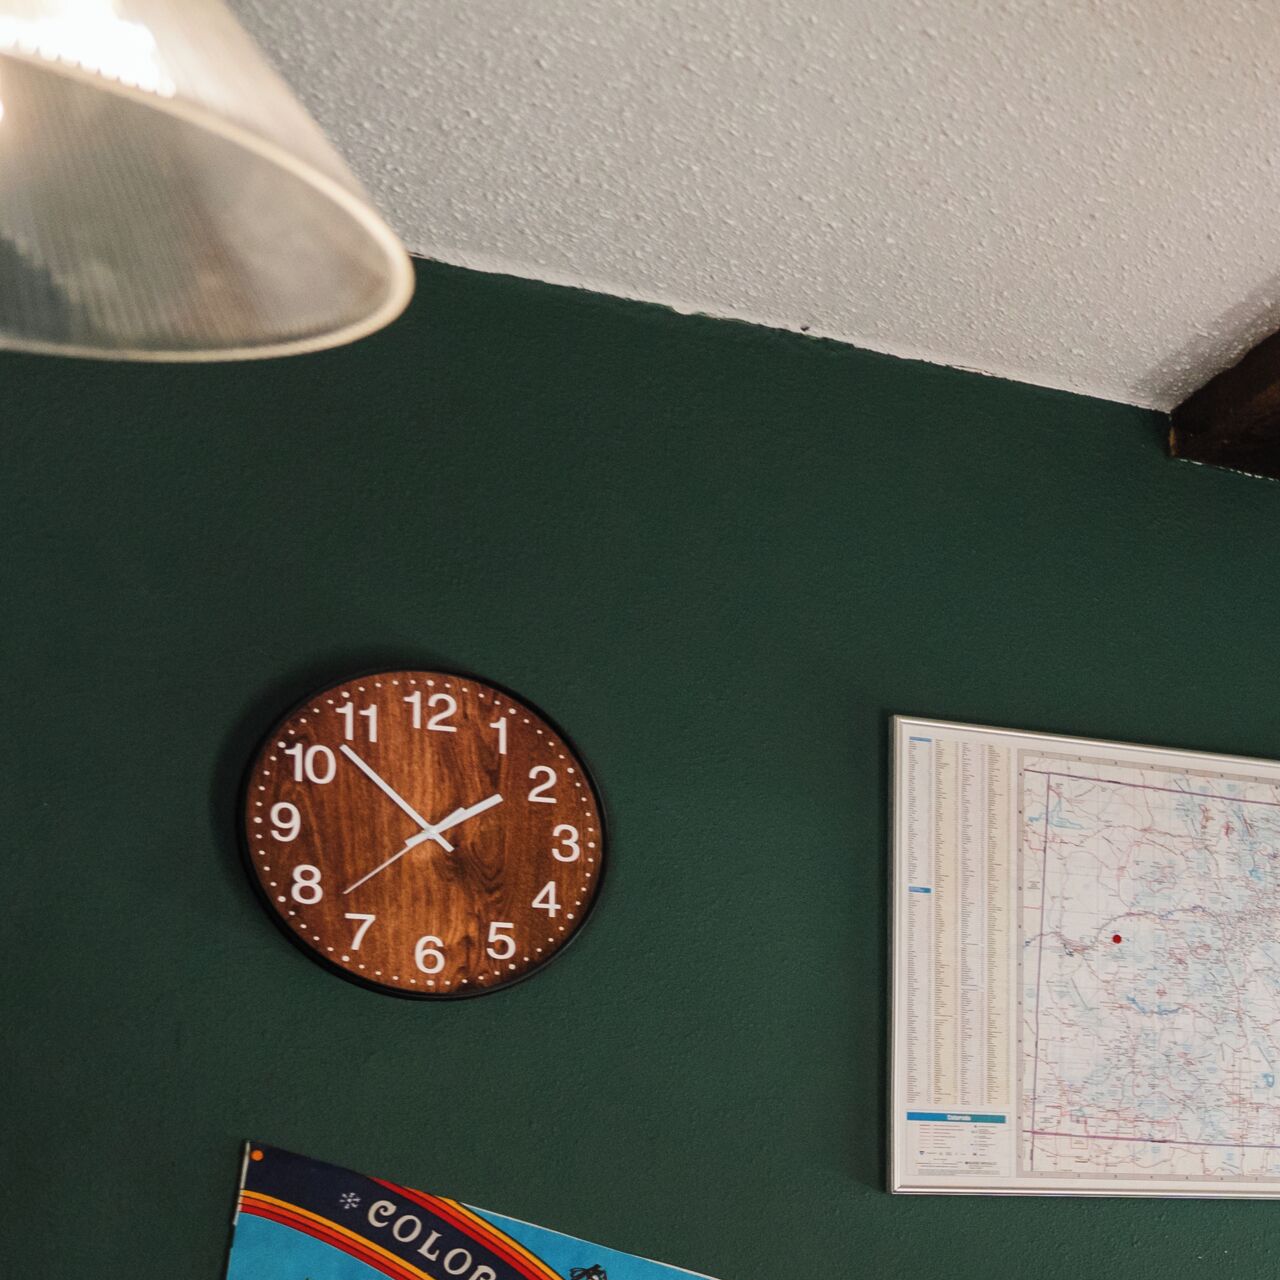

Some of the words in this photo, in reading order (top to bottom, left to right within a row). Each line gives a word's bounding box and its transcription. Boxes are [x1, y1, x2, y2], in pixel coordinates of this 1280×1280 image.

[335, 702, 377, 743] 11
[403, 690, 457, 733] 12
[489, 717, 508, 755] 1
[284, 743, 336, 785] 10
[527, 765, 557, 804] 2
[269, 802, 301, 842] 9
[551, 824, 580, 863] 3
[290, 864, 323, 905] 8
[532, 881, 561, 918] 4
[345, 913, 376, 951] 7
[486, 921, 516, 960] 5
[414, 935, 445, 974] 6
